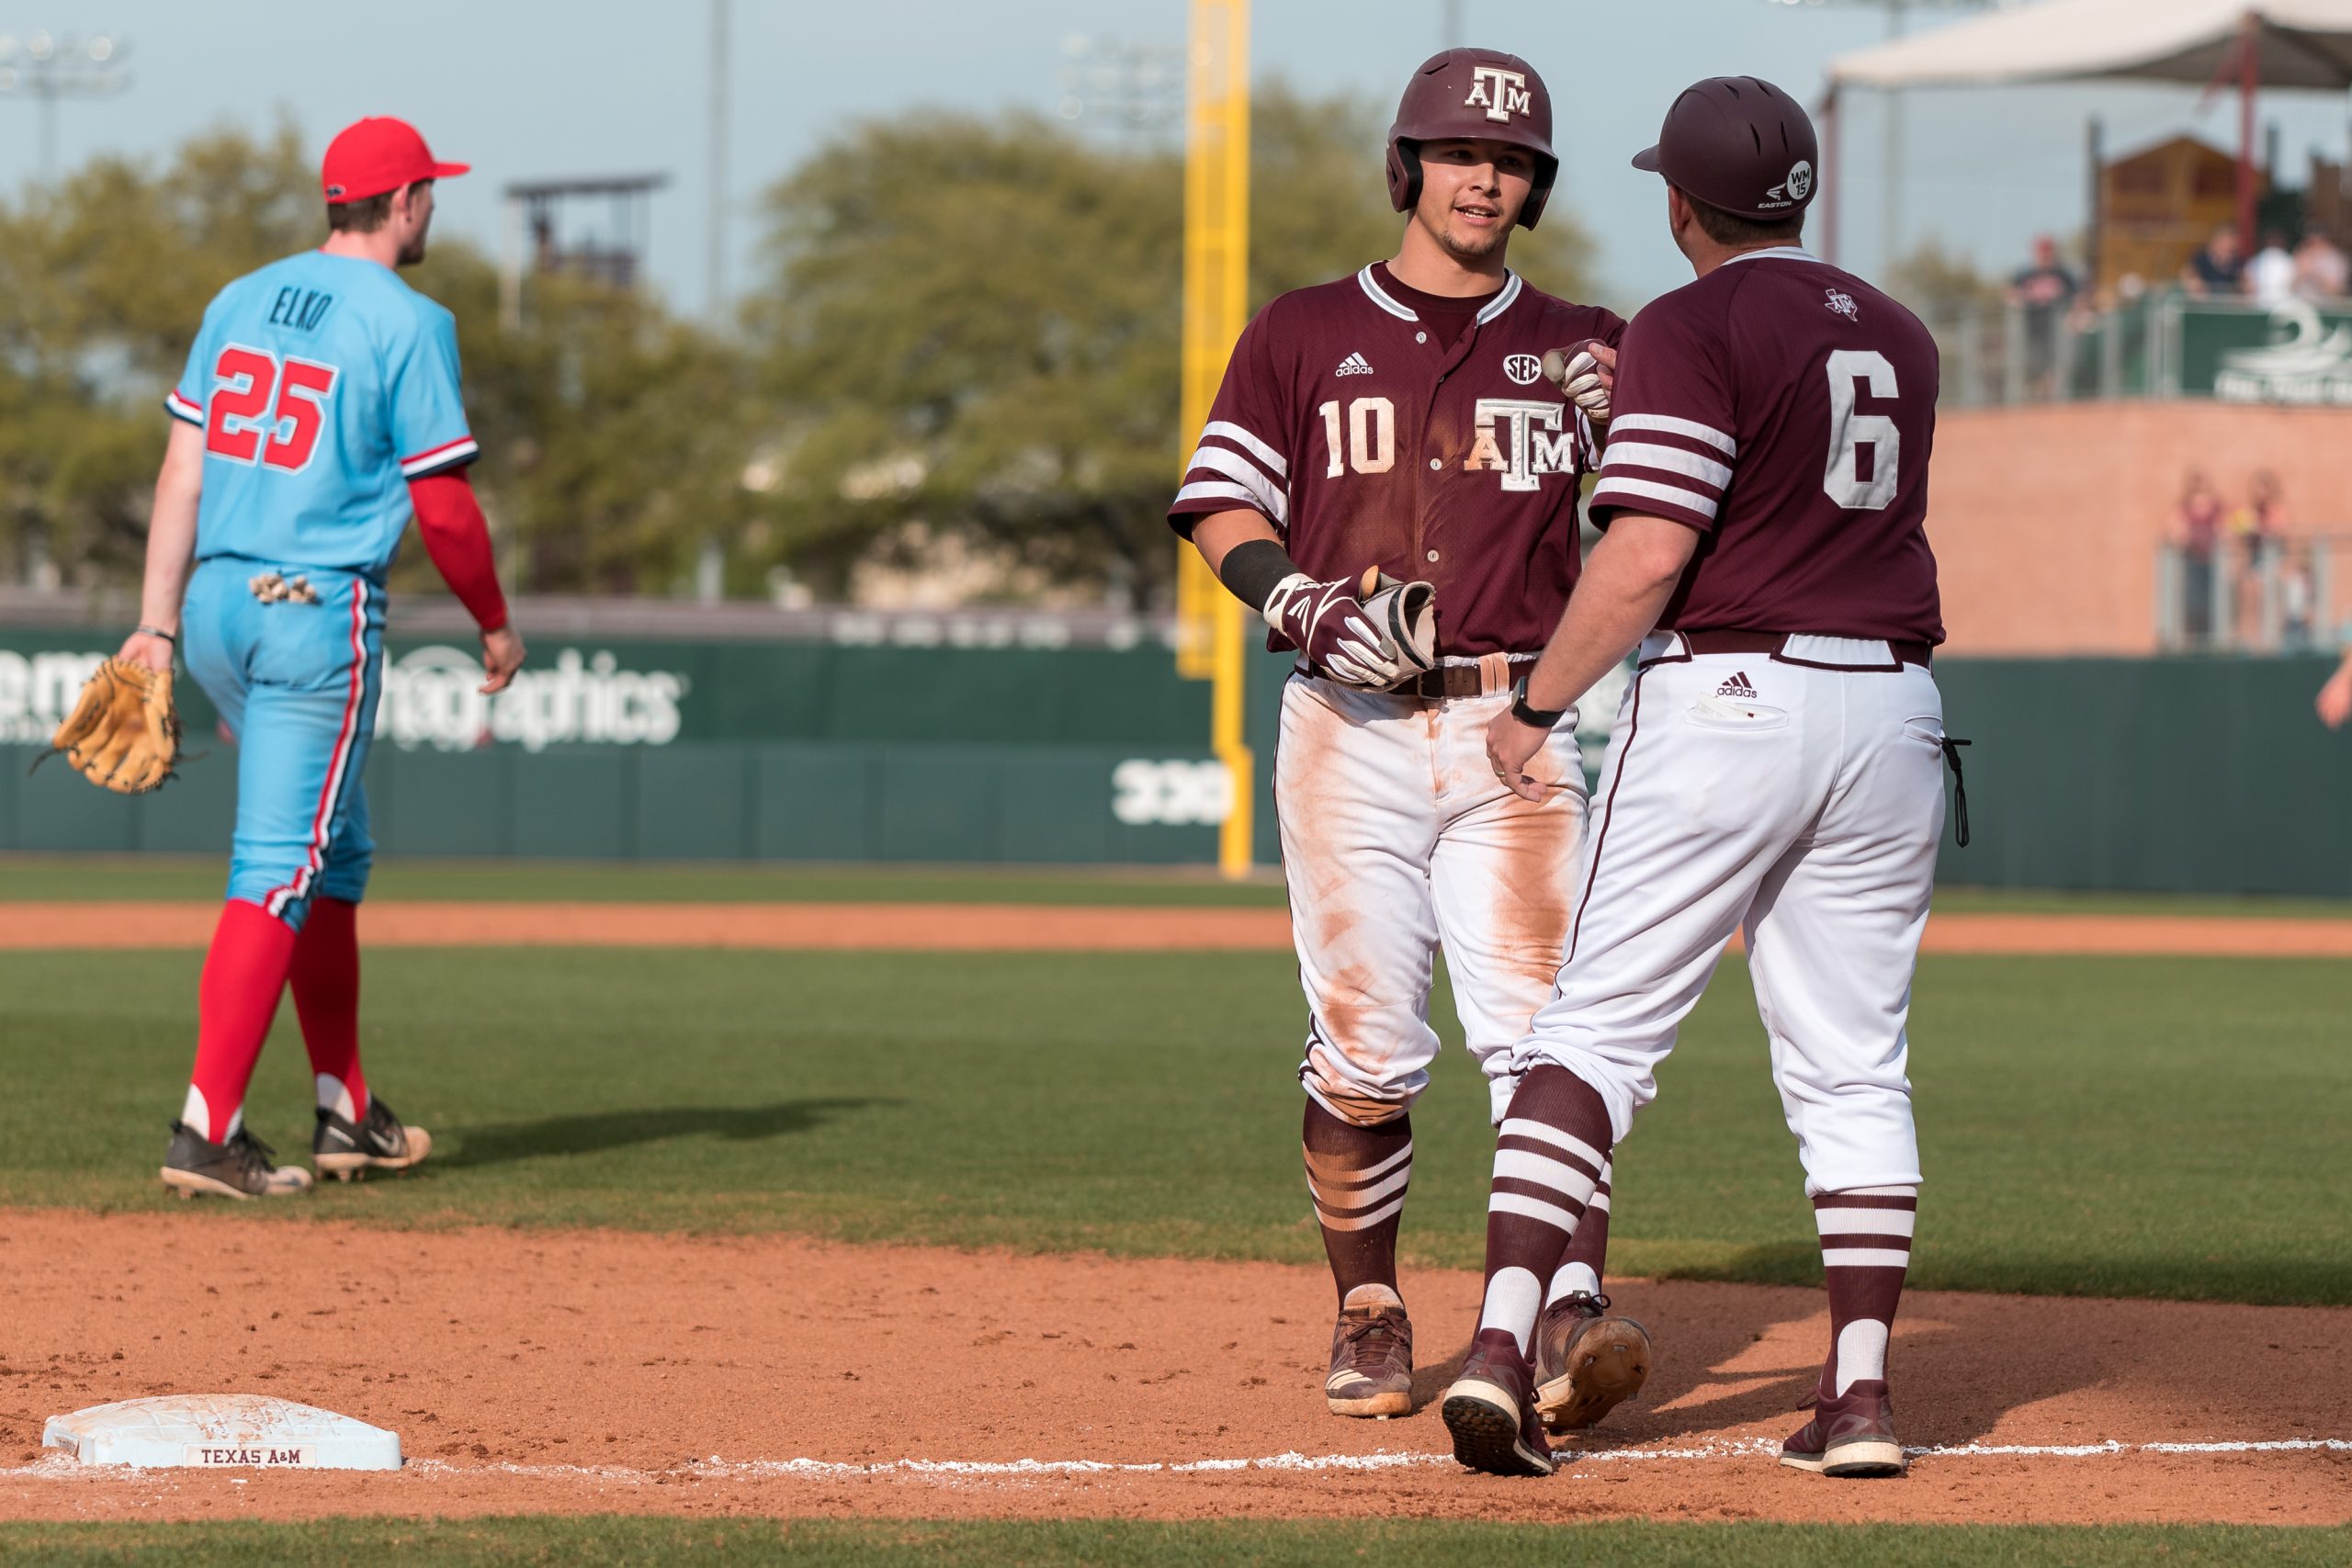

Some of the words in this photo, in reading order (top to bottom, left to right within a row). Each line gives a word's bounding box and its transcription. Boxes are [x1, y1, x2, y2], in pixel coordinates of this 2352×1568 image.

[1791, 168, 1810, 185] WM
[1795, 183, 1806, 196] 15
[1758, 200, 1792, 209] EASTON
[269, 285, 334, 332] ELKO
[1335, 364, 1374, 377] adidas
[1508, 356, 1540, 381] SEC
[204, 342, 340, 476] 25
[1318, 397, 1395, 479] 10
[1823, 349, 1901, 510] 6
[1717, 685, 1758, 698] adidas
[201, 1449, 261, 1464] TEXAS
[267, 1449, 301, 1464] A&M
